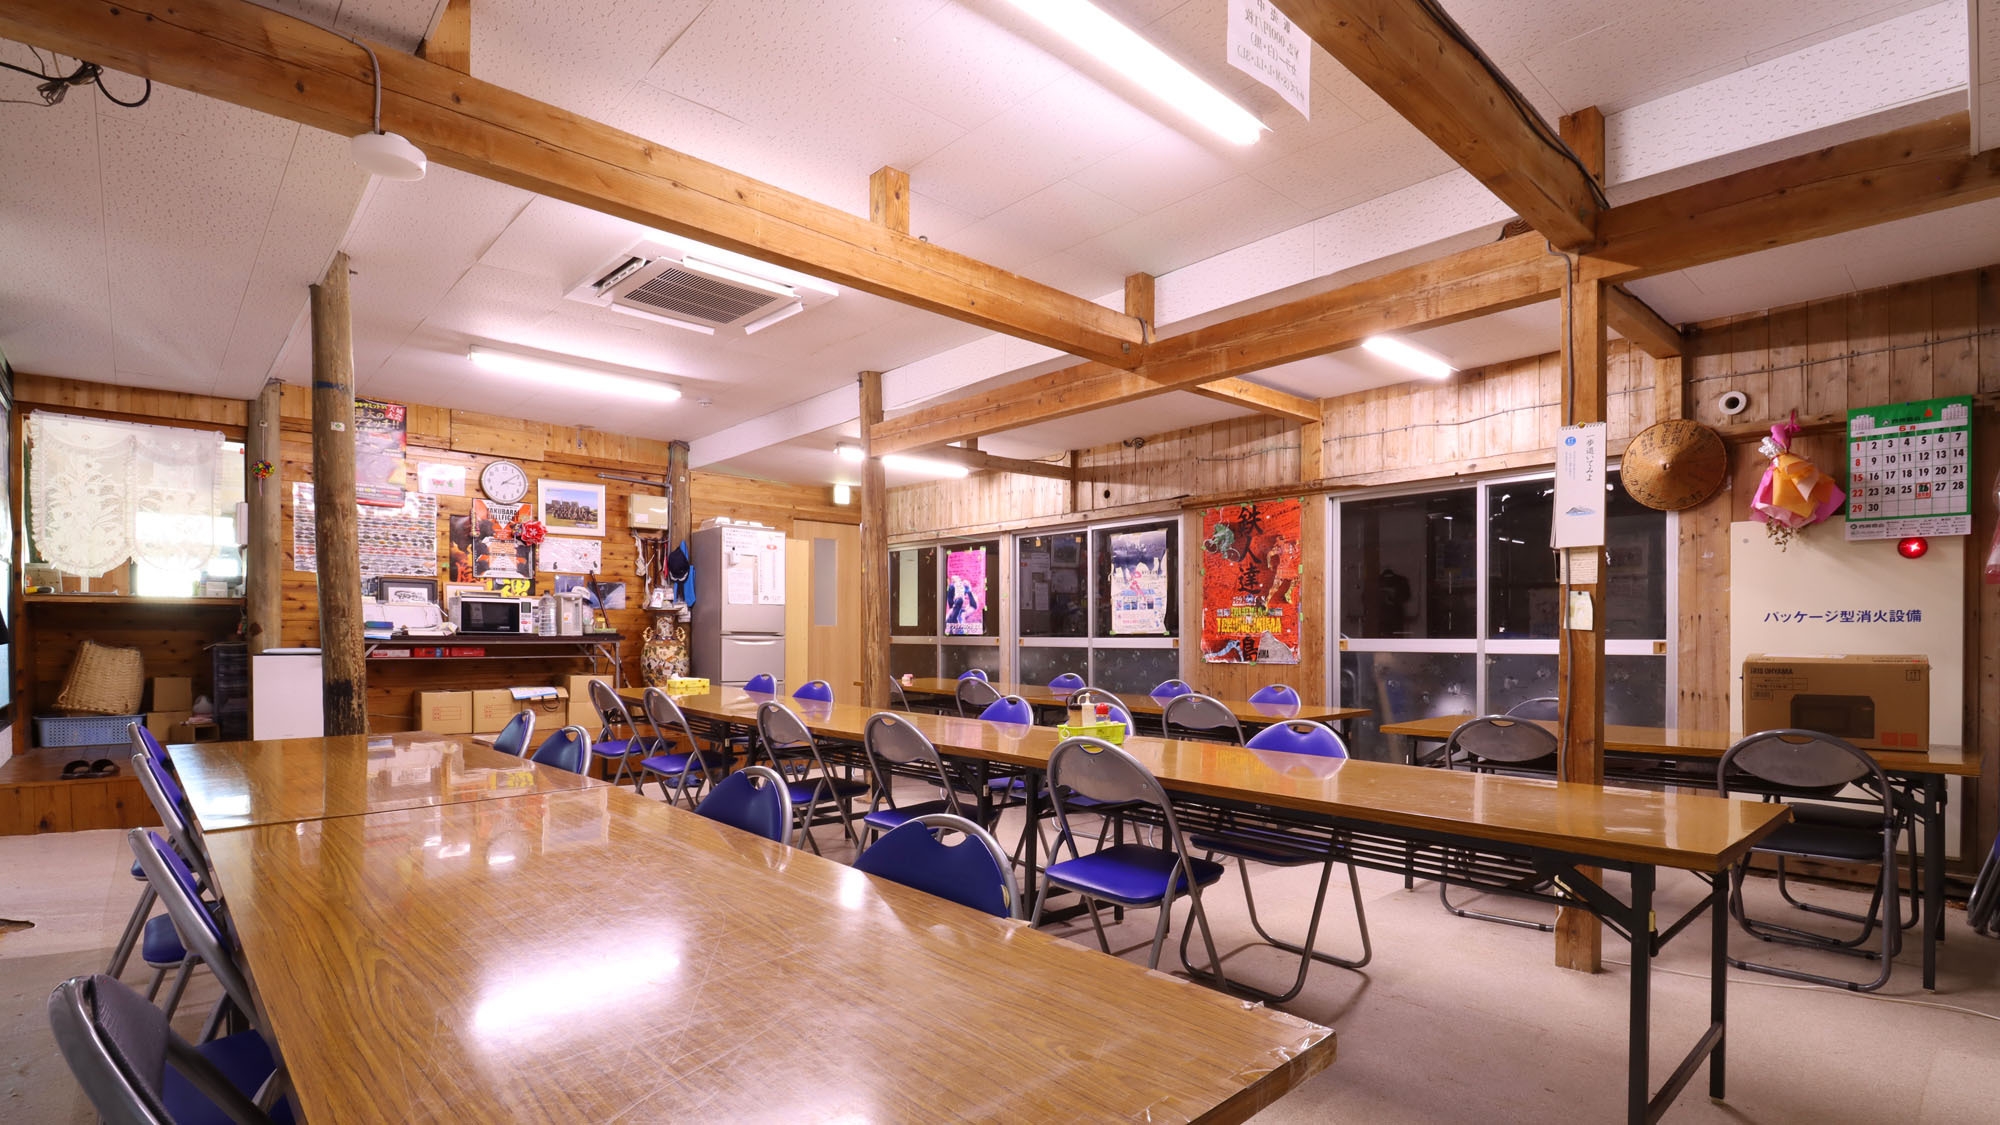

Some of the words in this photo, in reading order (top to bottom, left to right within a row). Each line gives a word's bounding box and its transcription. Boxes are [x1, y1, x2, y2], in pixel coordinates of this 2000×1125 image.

[1904, 438, 1910, 446] 4
[1956, 432, 1962, 440] 7
[1902, 454, 1912, 462] 11
[1919, 452, 1929, 460] 12
[1936, 450, 1946, 458] 13
[1954, 449, 1964, 457] 14
[1853, 474, 1863, 482] 15
[1902, 470, 1912, 478] 18
[1919, 468, 1929, 476] 19
[1936, 466, 1946, 475] 20
[1952, 465, 1964, 474] 21
[1852, 489, 1863, 498] 22
[1868, 488, 1879, 496] 23
[1885, 486, 1896, 495] 24
[1901, 486, 1912, 494] 25
[1918, 484, 1928, 492] 26
[1935, 483, 1946, 491] 27
[1952, 482, 1964, 490] 28
[1852, 504, 1862, 512] 29
[1868, 504, 1878, 512] 30
[1238, 505, 1264, 594] 鉄人達
[1764, 609, 1922, 624] パッケージ型消火設備
[1242, 636, 1258, 662] 島
